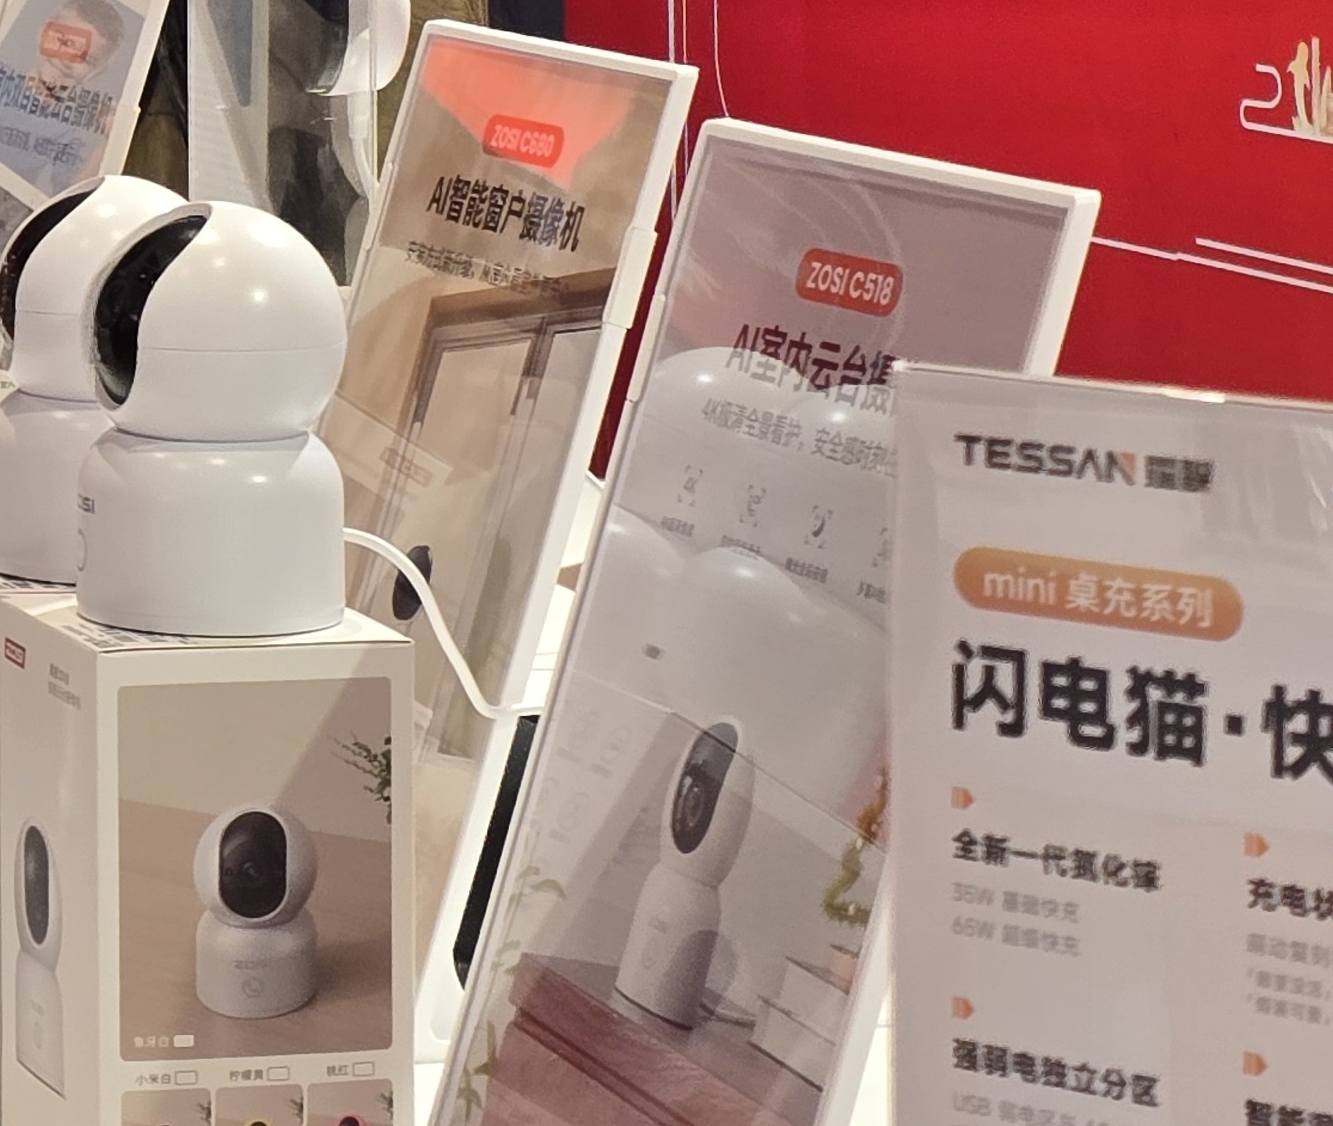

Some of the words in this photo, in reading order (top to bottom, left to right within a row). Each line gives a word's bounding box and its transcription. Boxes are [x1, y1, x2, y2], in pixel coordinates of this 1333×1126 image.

[490, 124, 521, 151] ZOSI
[426, 174, 585, 253] AI智能窗户摄像机
[805, 261, 850, 296] ZOSI
[848, 271, 895, 306] C518
[953, 433, 1137, 486] TESSAN
[983, 566, 1058, 607] mini
[1064, 571, 1214, 628] 桌充系列
[951, 638, 1333, 783] 闪电猫·快
[952, 1037, 1160, 1108] 强弱电独立分区
